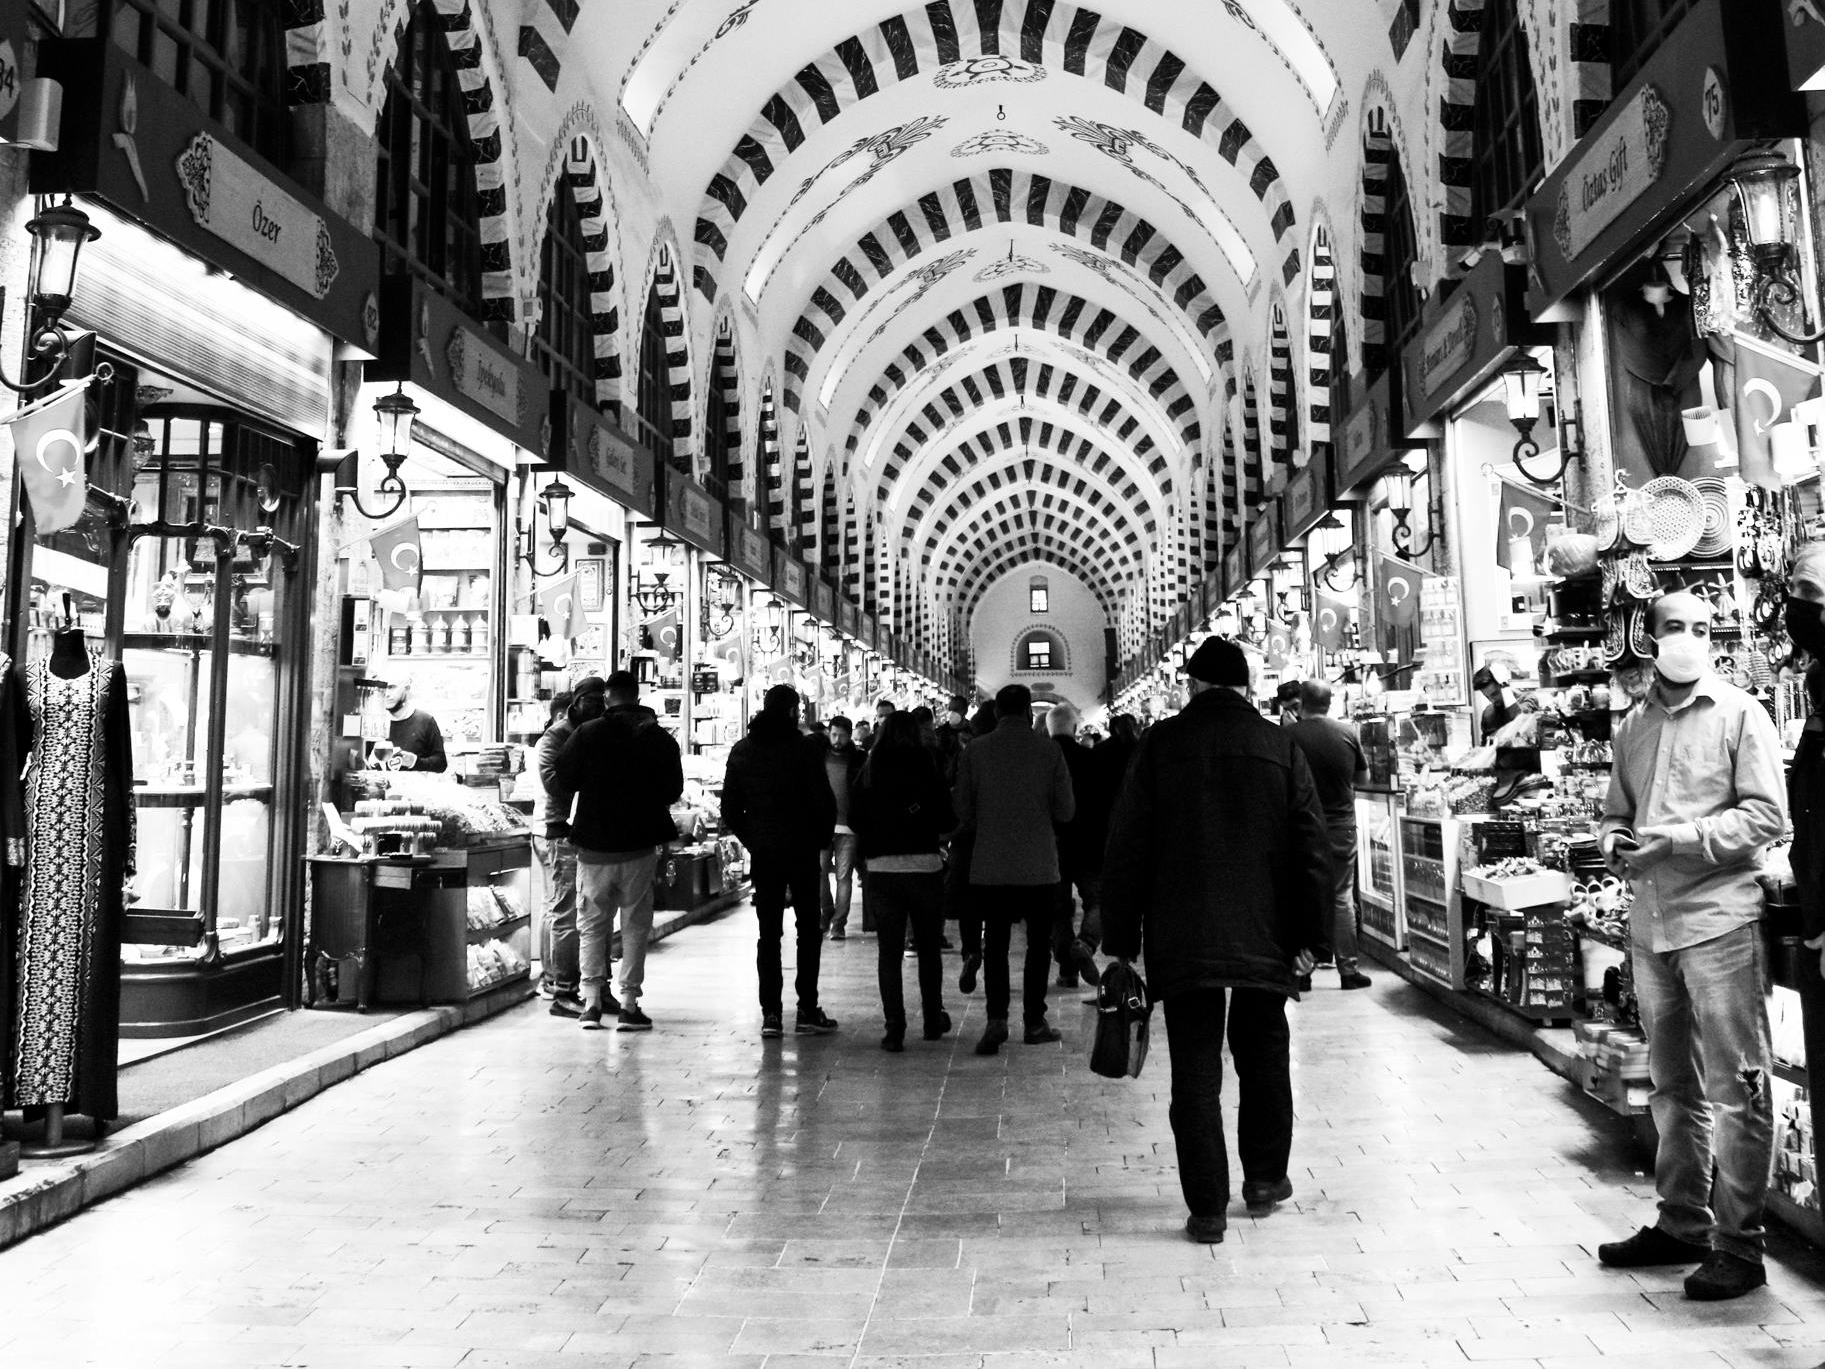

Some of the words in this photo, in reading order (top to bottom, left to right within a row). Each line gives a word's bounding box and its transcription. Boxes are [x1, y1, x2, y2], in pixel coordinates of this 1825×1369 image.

[1705, 82, 1720, 124] 75
[1609, 136, 1628, 192] Gift
[252, 199, 282, 244] Özer
